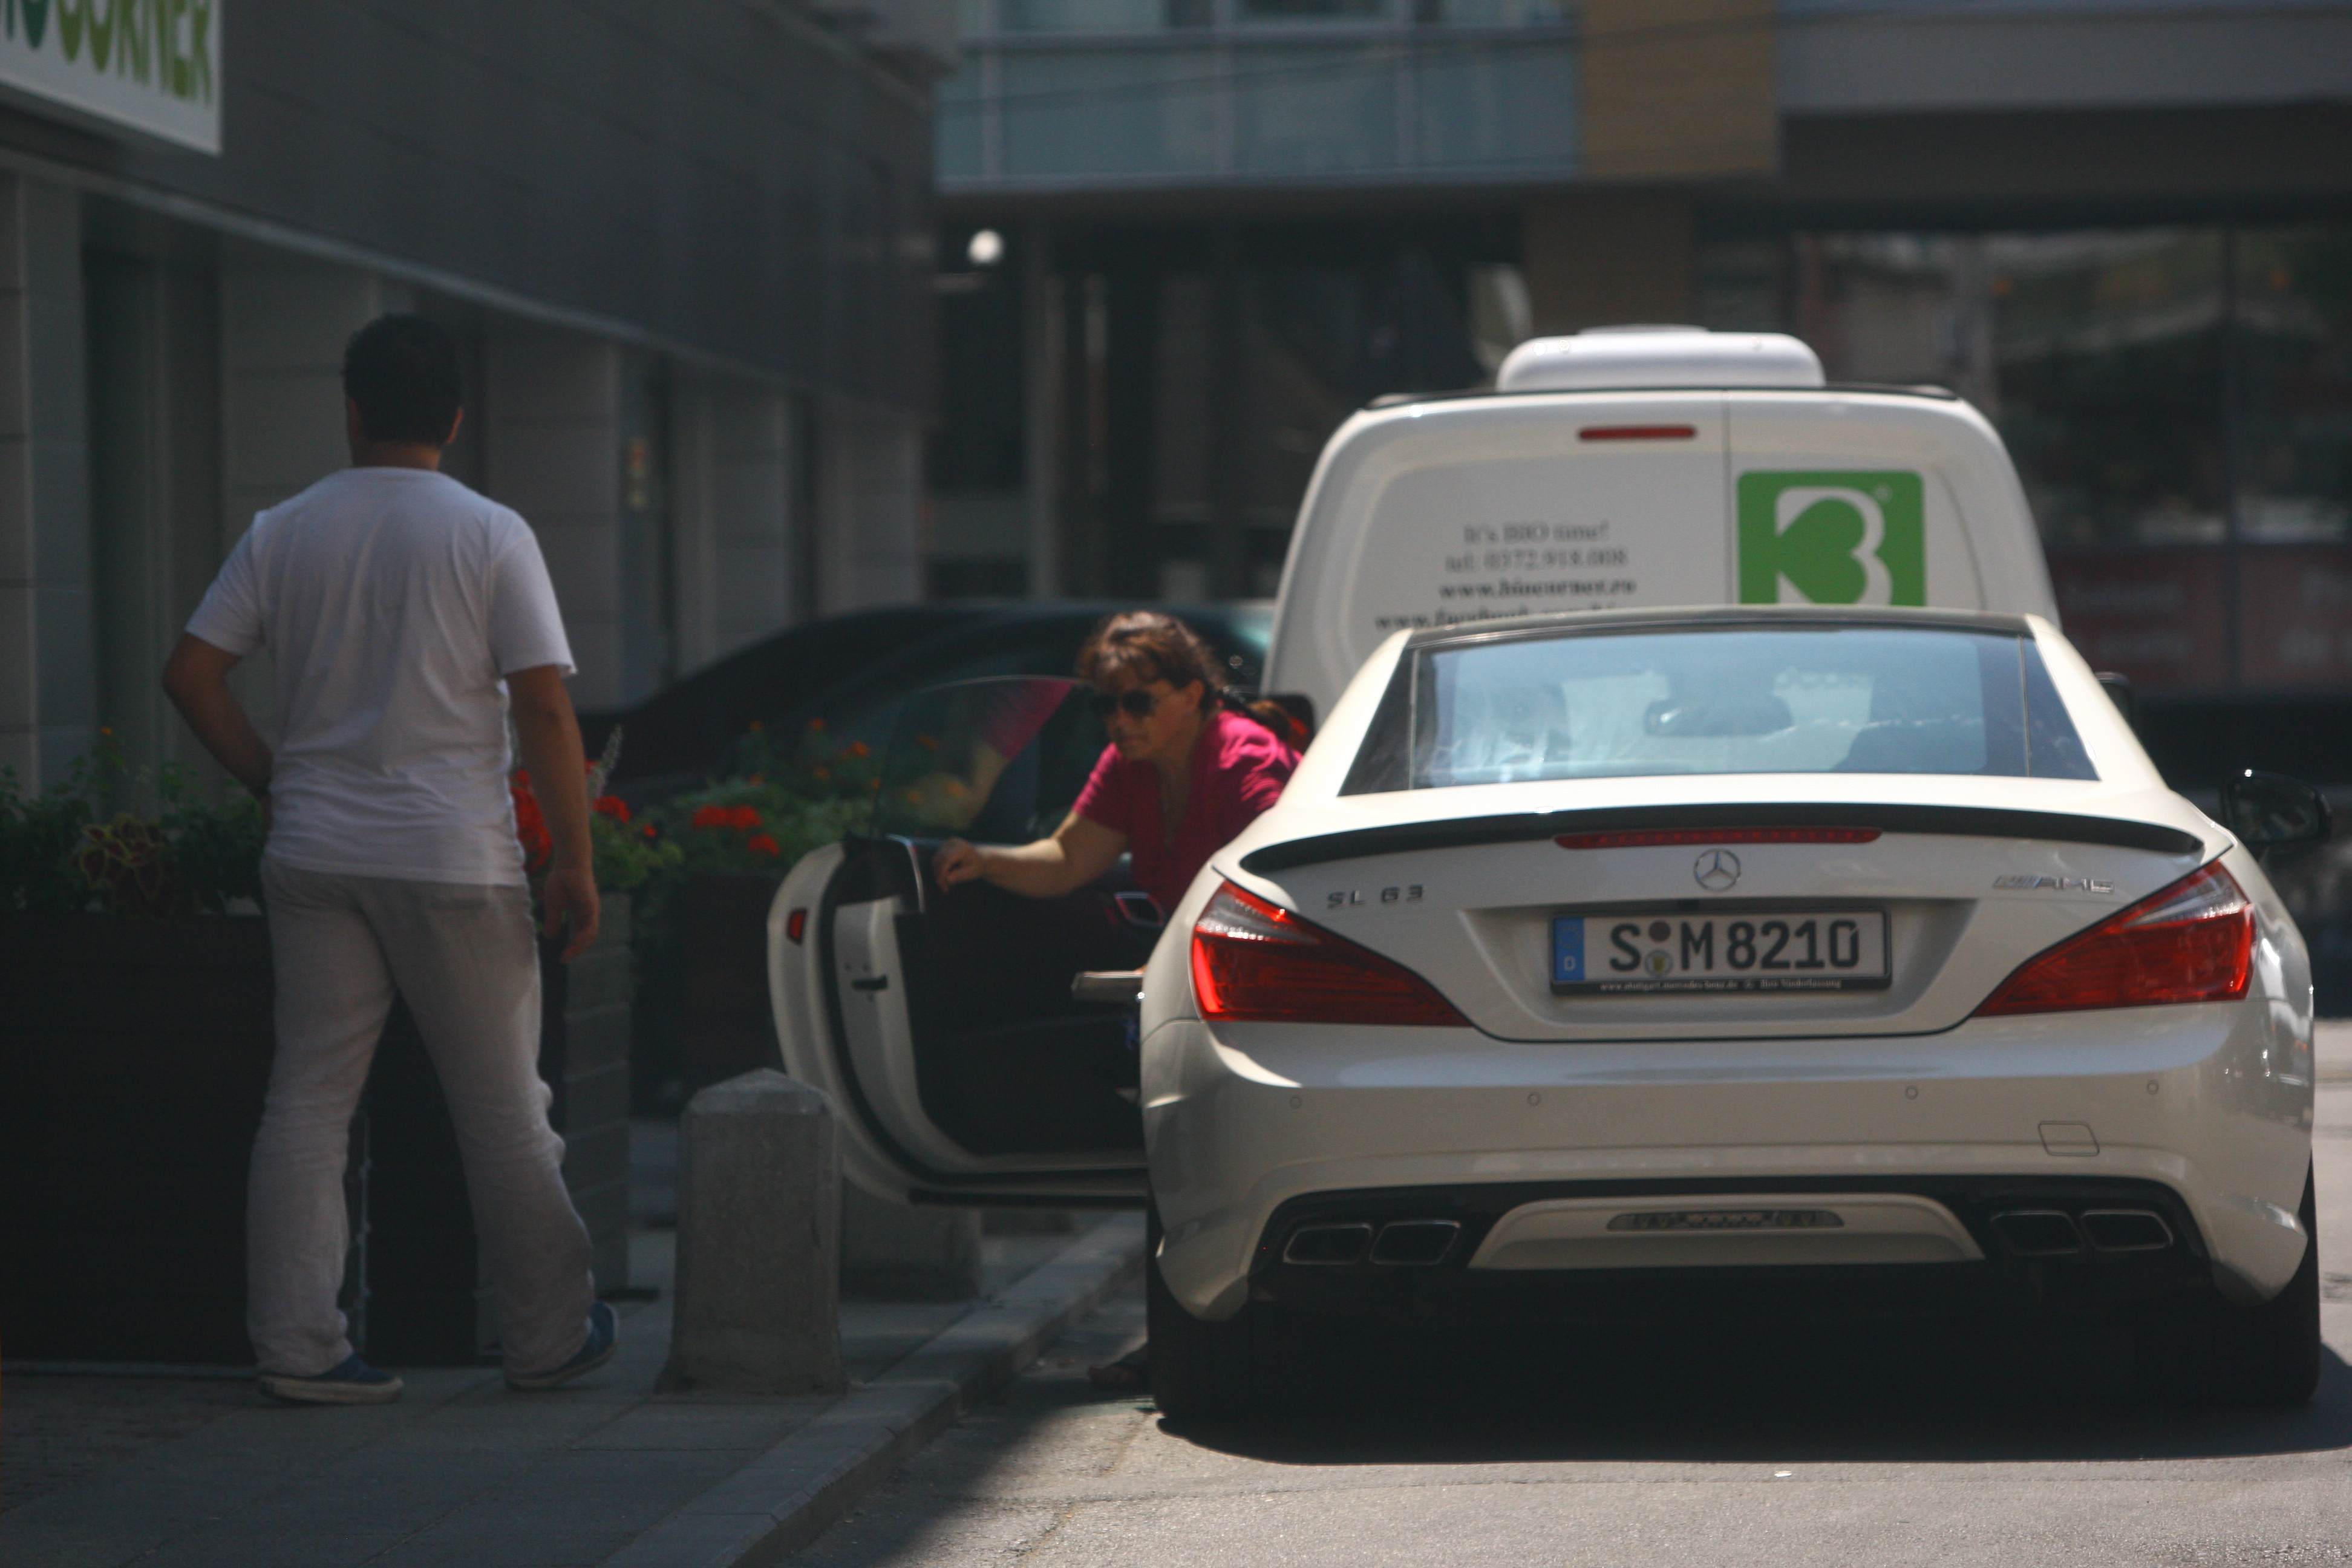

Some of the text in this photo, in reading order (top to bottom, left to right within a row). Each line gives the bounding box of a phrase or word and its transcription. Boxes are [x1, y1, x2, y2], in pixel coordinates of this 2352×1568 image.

[1328, 884, 1423, 909] SL 63
[1564, 956, 1575, 970] D
